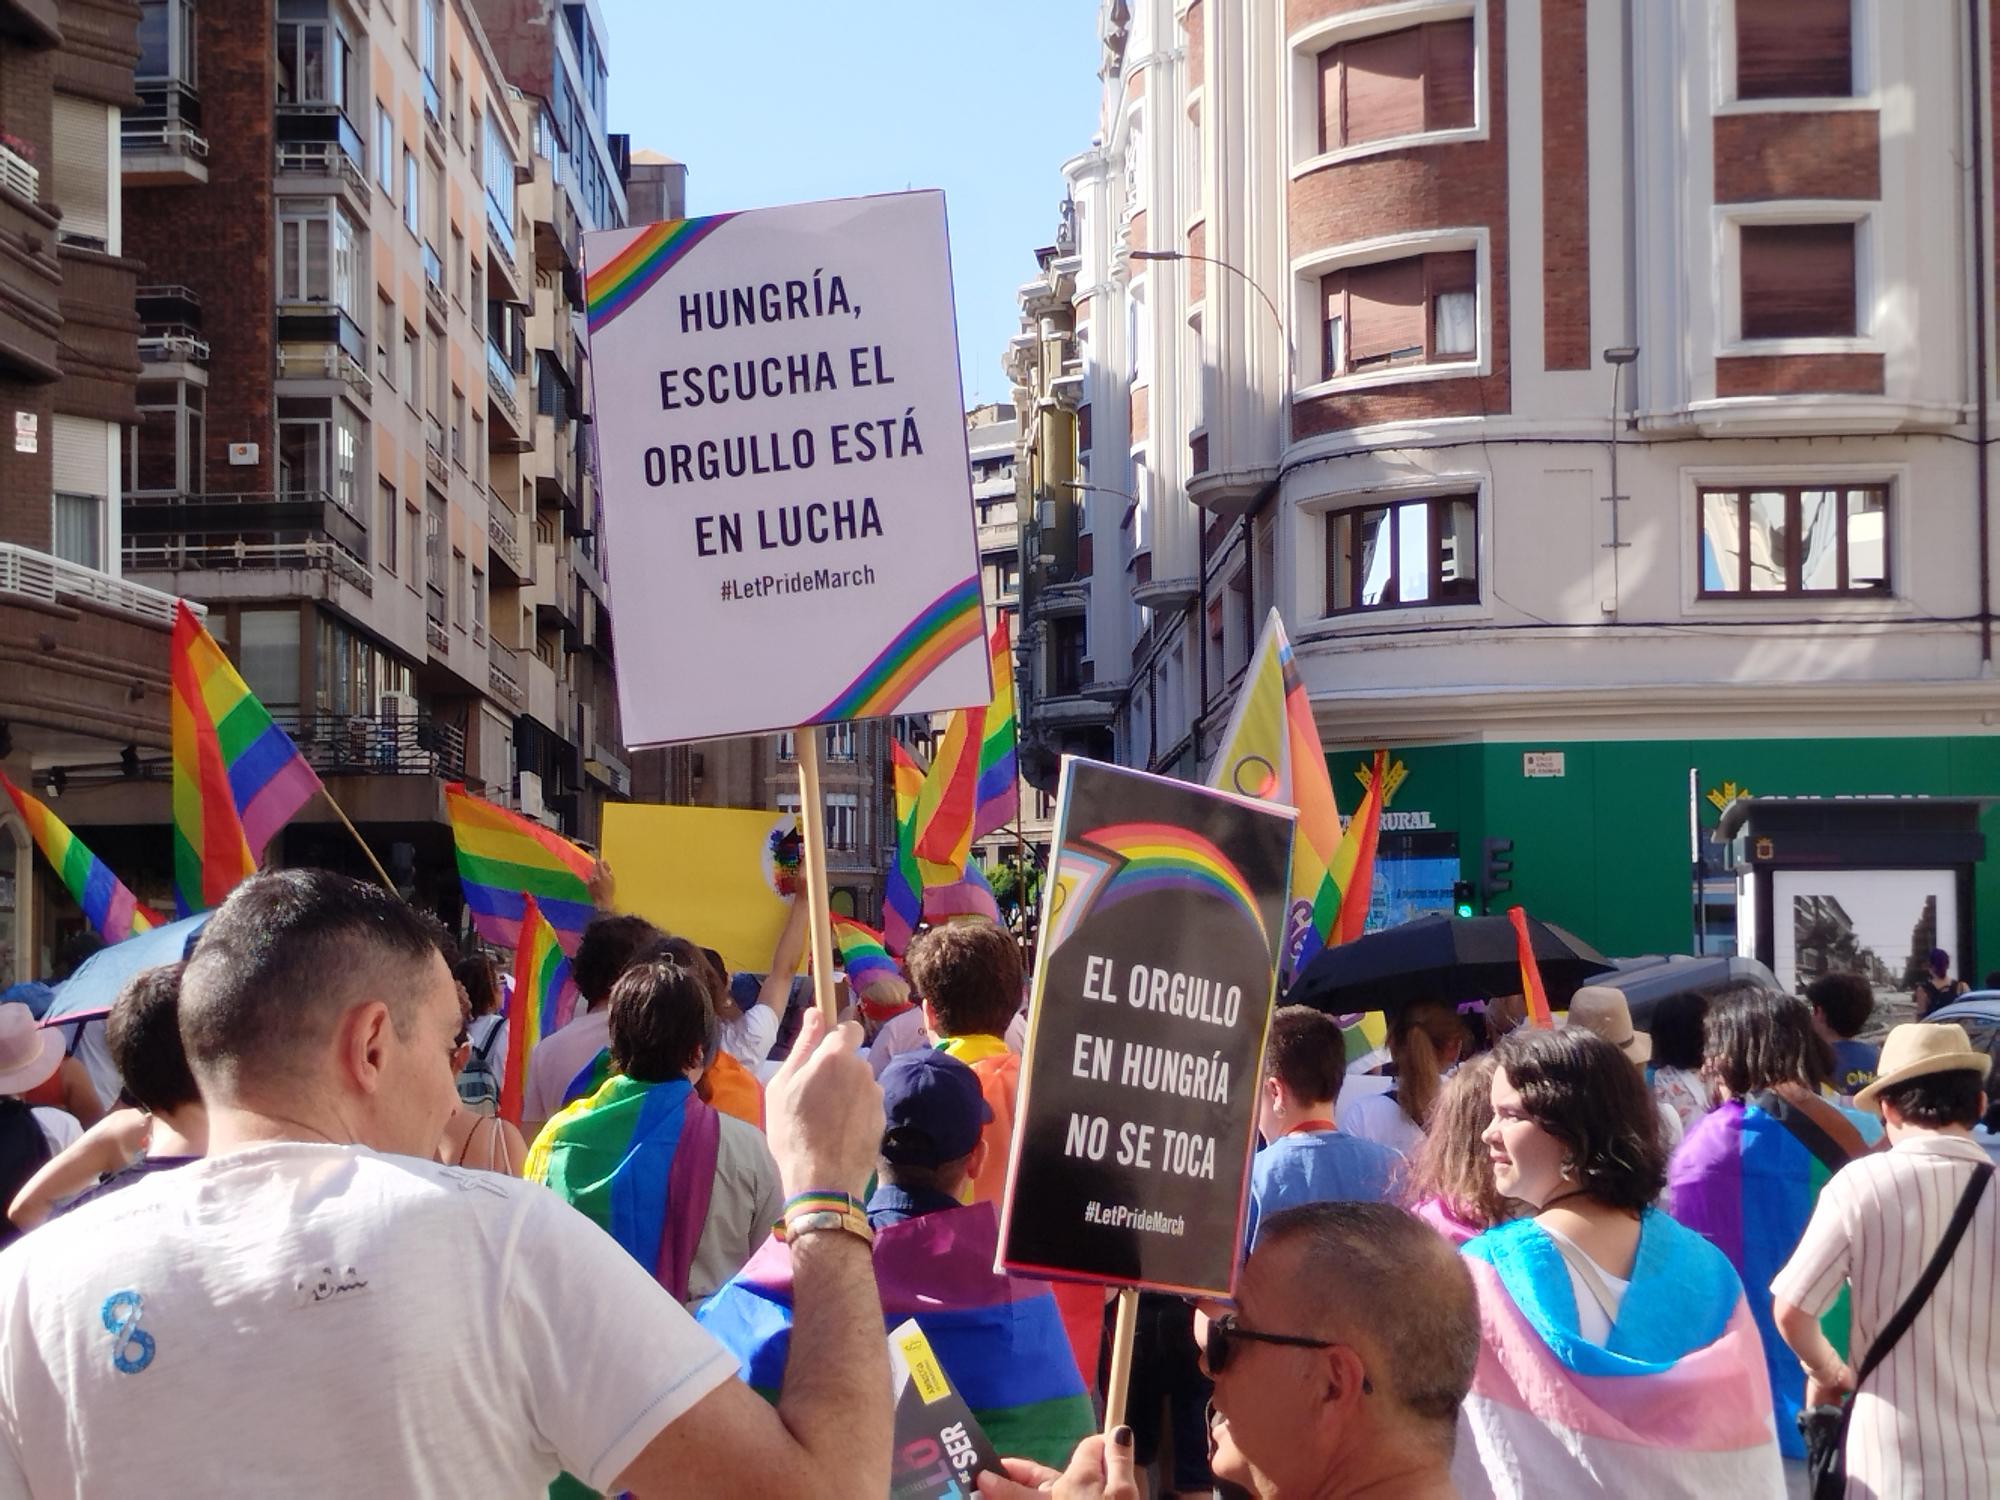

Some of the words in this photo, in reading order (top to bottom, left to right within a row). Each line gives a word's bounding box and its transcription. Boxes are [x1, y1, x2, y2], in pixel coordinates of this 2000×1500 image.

[679, 267, 862, 334] HUNGRÍA,
[659, 351, 838, 411] ESCUCHA
[849, 345, 895, 388] EL
[643, 428, 815, 487] ORGULLO
[830, 406, 924, 466] ESTÁ
[694, 512, 743, 558] EN
[757, 497, 884, 550] LUCHA
[720, 564, 876, 602] #LetPrideMarch
[1379, 811, 1436, 831] RURAL
[1082, 955, 1118, 1004] EL
[1128, 964, 1242, 1028] ORGULLO
[1072, 1033, 1114, 1082] EN
[1120, 1042, 1230, 1105] HUNGRÍA
[1064, 1113, 1109, 1161] NO
[1116, 1121, 1156, 1169] SE
[1161, 1128, 1216, 1180] TOCA
[1084, 1200, 1185, 1237] #LetPrideMarch
[940, 1421, 978, 1470] SER
